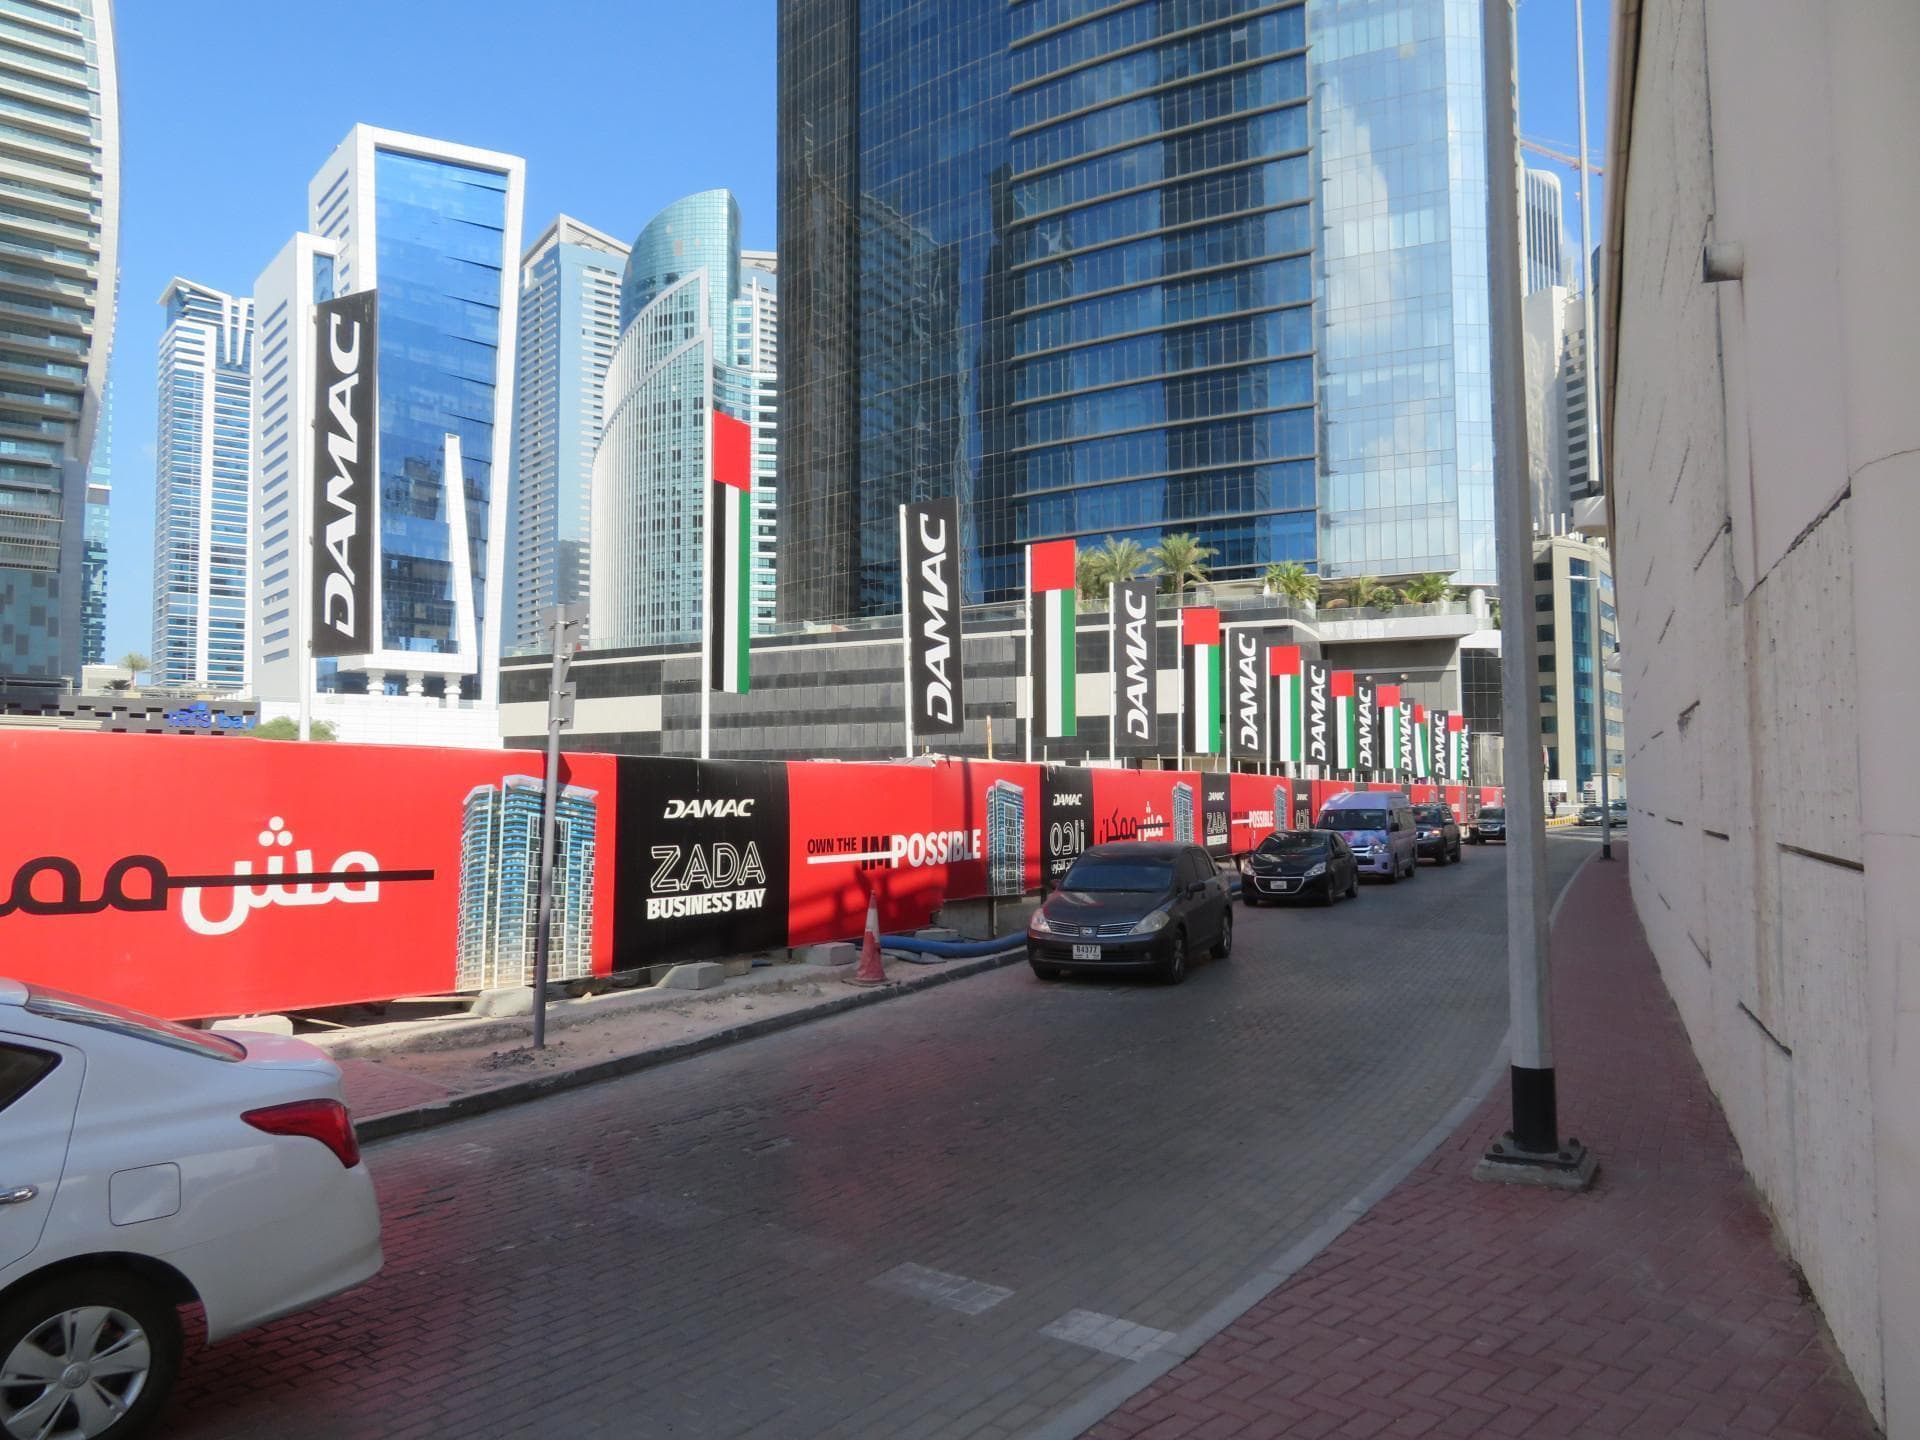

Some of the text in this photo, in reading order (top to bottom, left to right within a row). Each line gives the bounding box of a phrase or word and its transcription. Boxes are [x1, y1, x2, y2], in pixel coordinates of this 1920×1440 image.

[324, 312, 360, 637] DAMAC
[919, 512, 953, 724] DAMAC
[1125, 589, 1149, 740] DAMAC
[1238, 633, 1258, 750] DAMAC
[1310, 665, 1326, 761] DAMAC
[1358, 686, 1372, 767] DAMAC
[1400, 701, 1413, 772] DAMAC
[1434, 713, 1446, 775] DAMAC
[663, 799, 755, 819] DAMAC
[1053, 793, 1083, 806] DAMAC
[650, 841, 766, 893] ZADA
[807, 829, 981, 871] OWN THE IMPOSSIBLE
[647, 888, 766, 920] BUSINESS BAY
